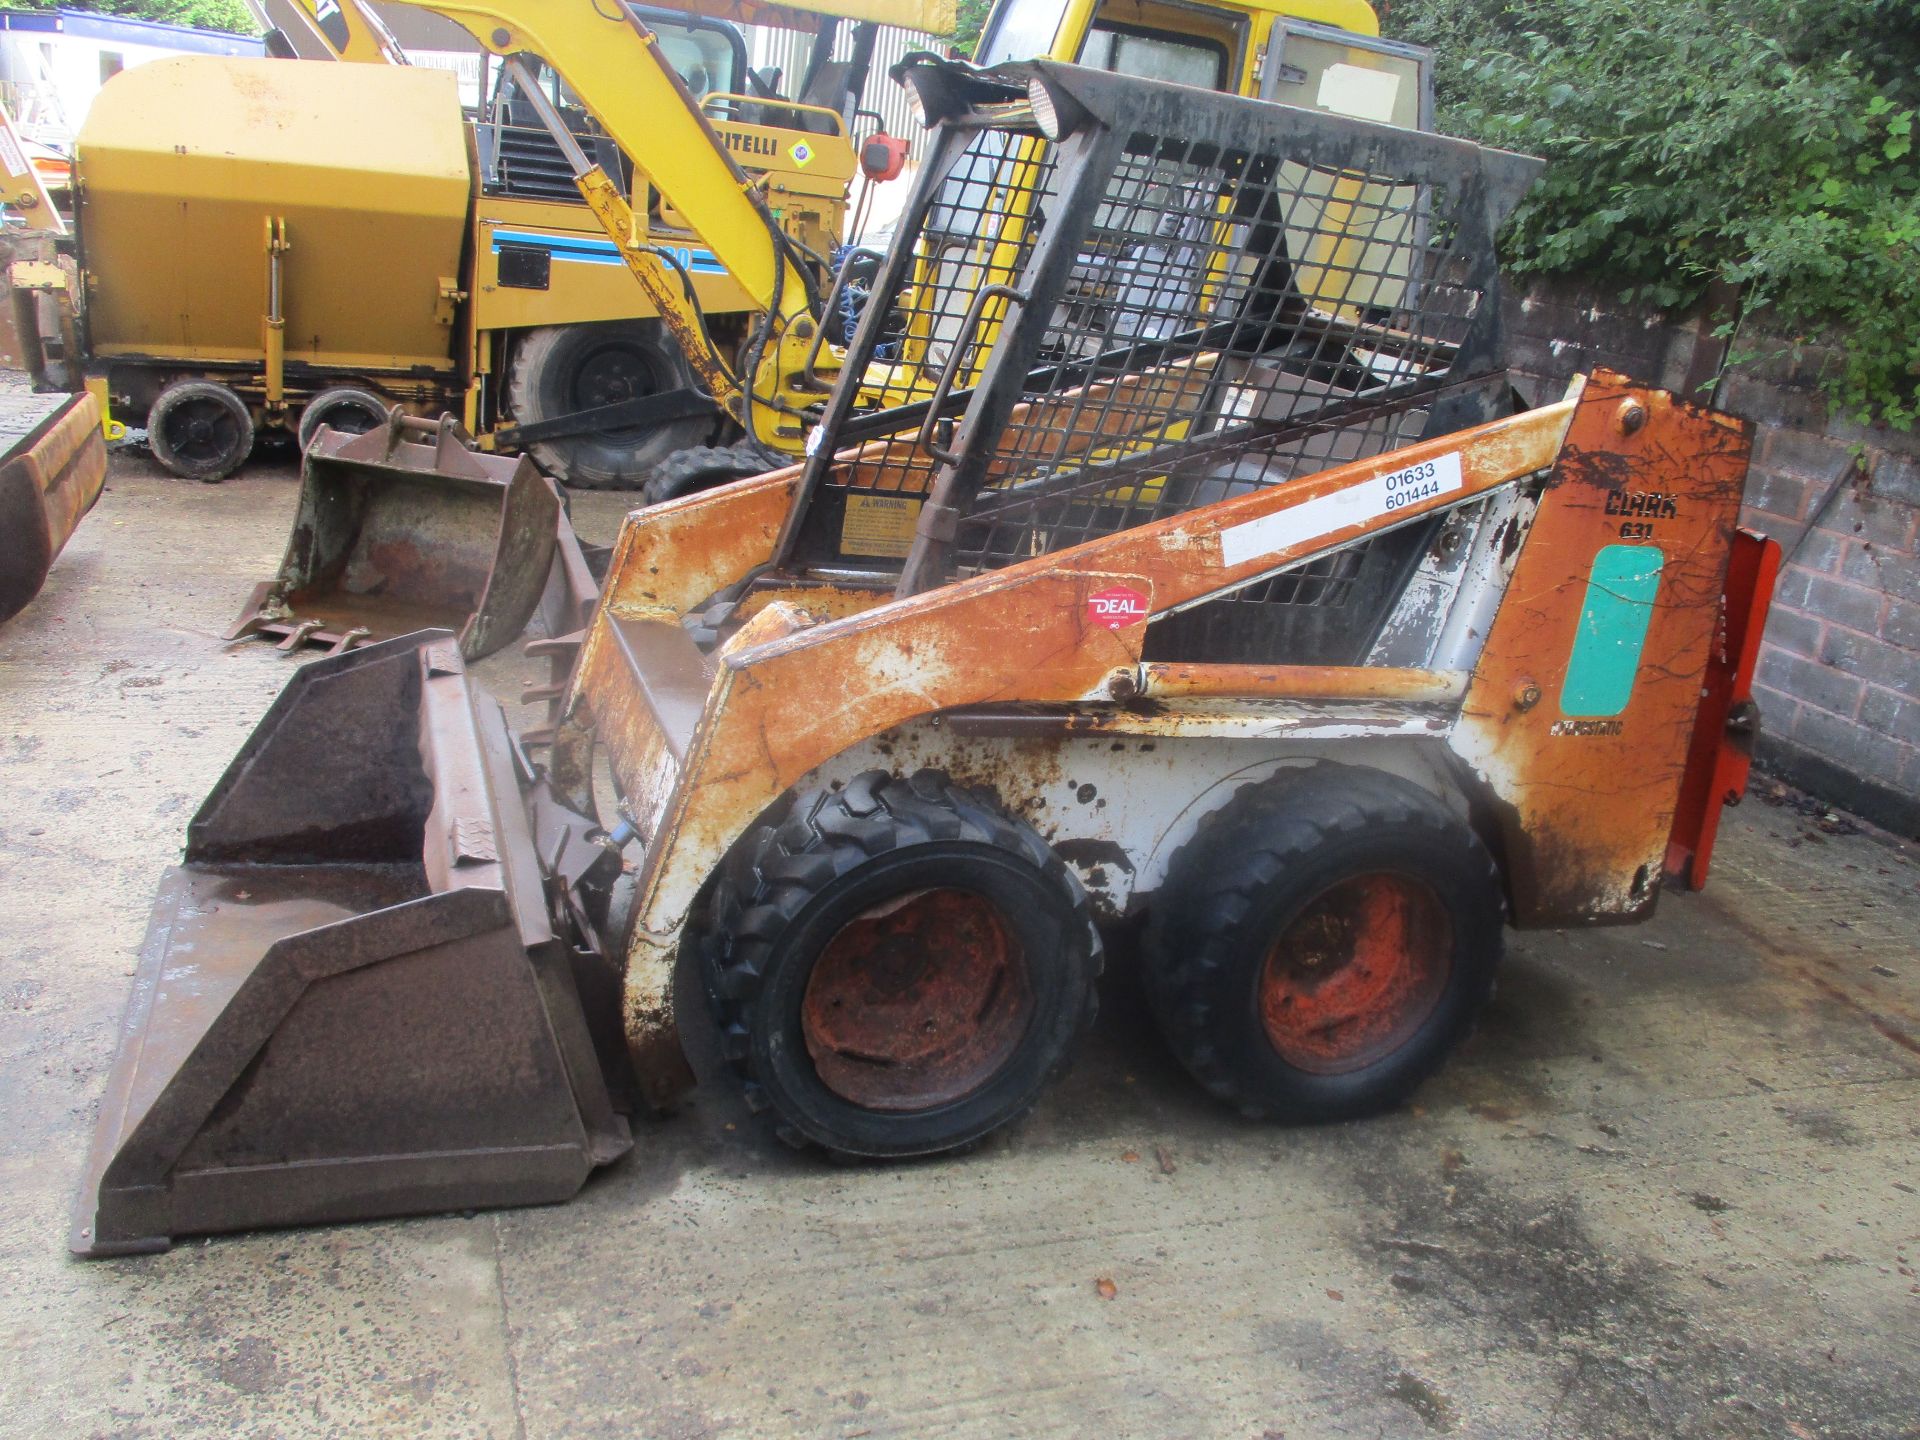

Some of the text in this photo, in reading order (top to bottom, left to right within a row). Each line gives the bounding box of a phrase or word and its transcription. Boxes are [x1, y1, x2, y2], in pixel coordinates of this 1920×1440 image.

[1386, 463, 1435, 490] 01633
[873, 498, 907, 510] WARNING
[1386, 481, 1439, 510] 601444
[1605, 489, 1678, 519] CLARK
[1620, 521, 1654, 539] 631
[1089, 599, 1146, 614] DEAL
